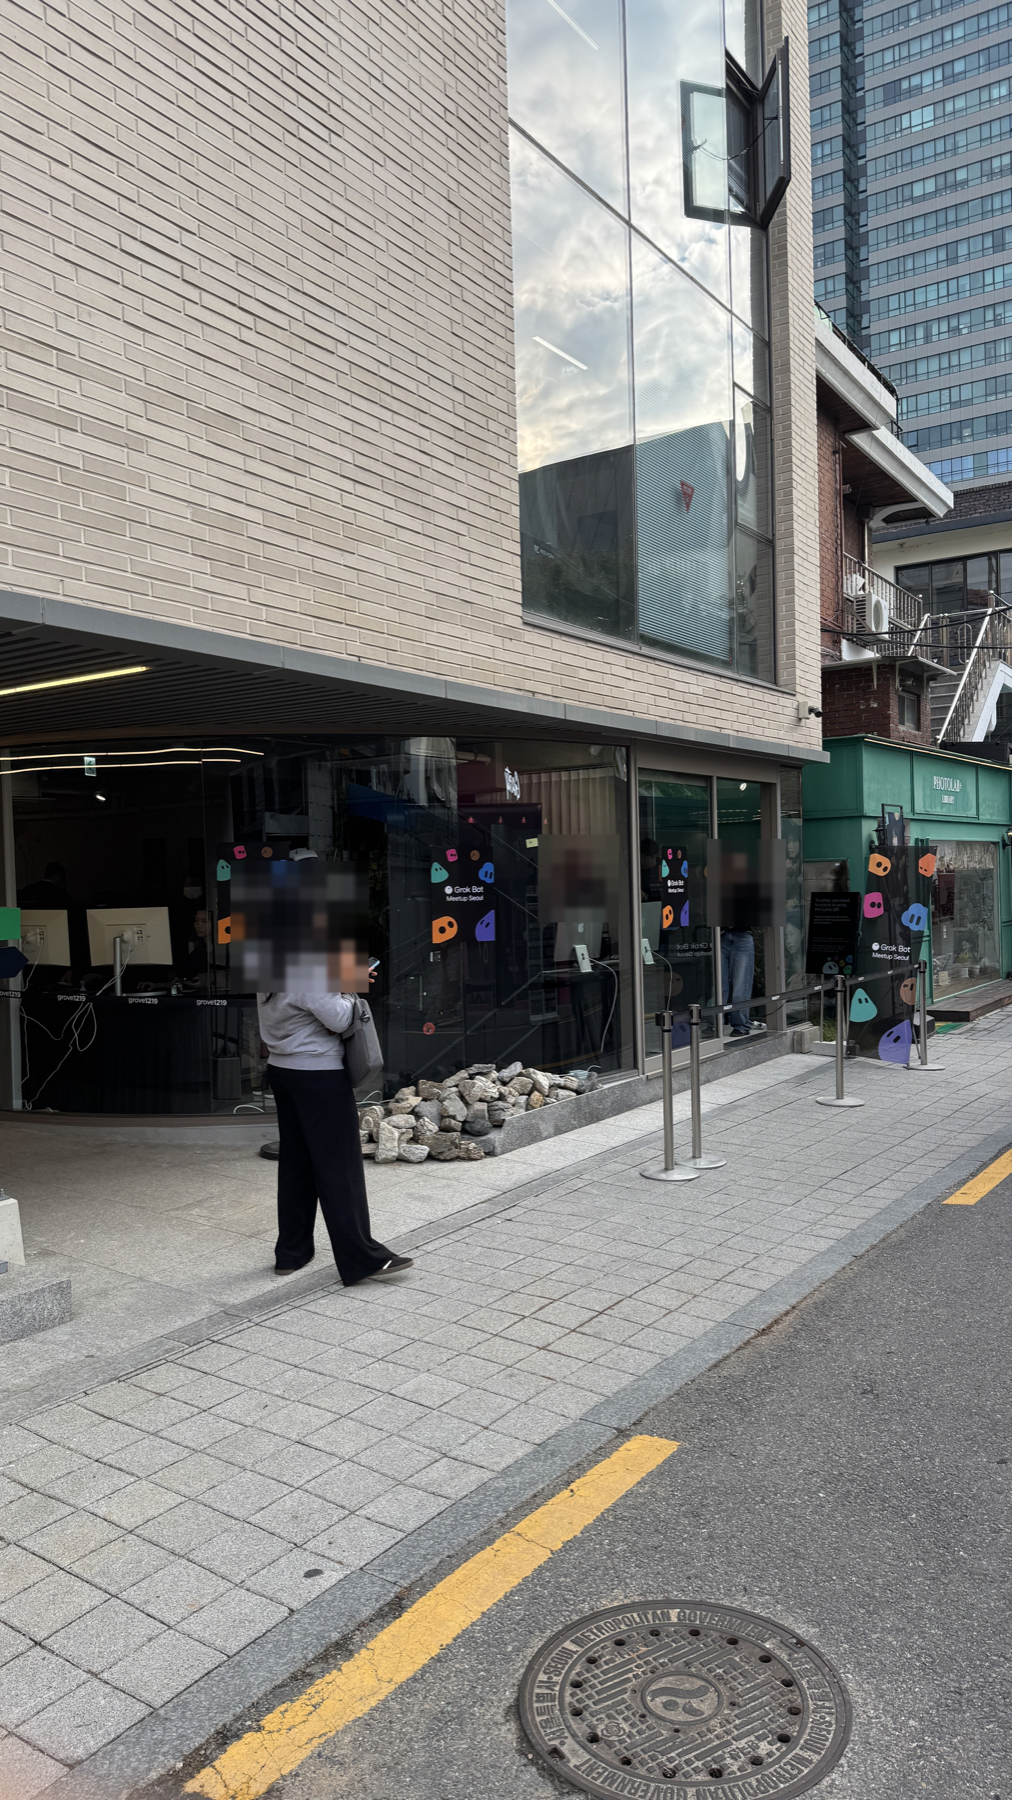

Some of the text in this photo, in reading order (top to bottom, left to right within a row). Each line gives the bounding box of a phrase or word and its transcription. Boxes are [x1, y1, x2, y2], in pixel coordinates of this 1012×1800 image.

[454, 885, 484, 893] Grok Bot
[880, 943, 911, 953] Grok Bot
[871, 952, 910, 961] Meetup Seoul
[57, 994, 86, 1002] grove1219
[128, 997, 158, 1005] grove1219
[534, 1609, 772, 1742] 서울특별시 SEOUL METROPOLITAN GOVERNMENT
[799, 1718, 833, 1756] SEOUL
[573, 1757, 690, 1800] GOVERNMENT
[695, 1752, 814, 1800] METROPOLITAN
